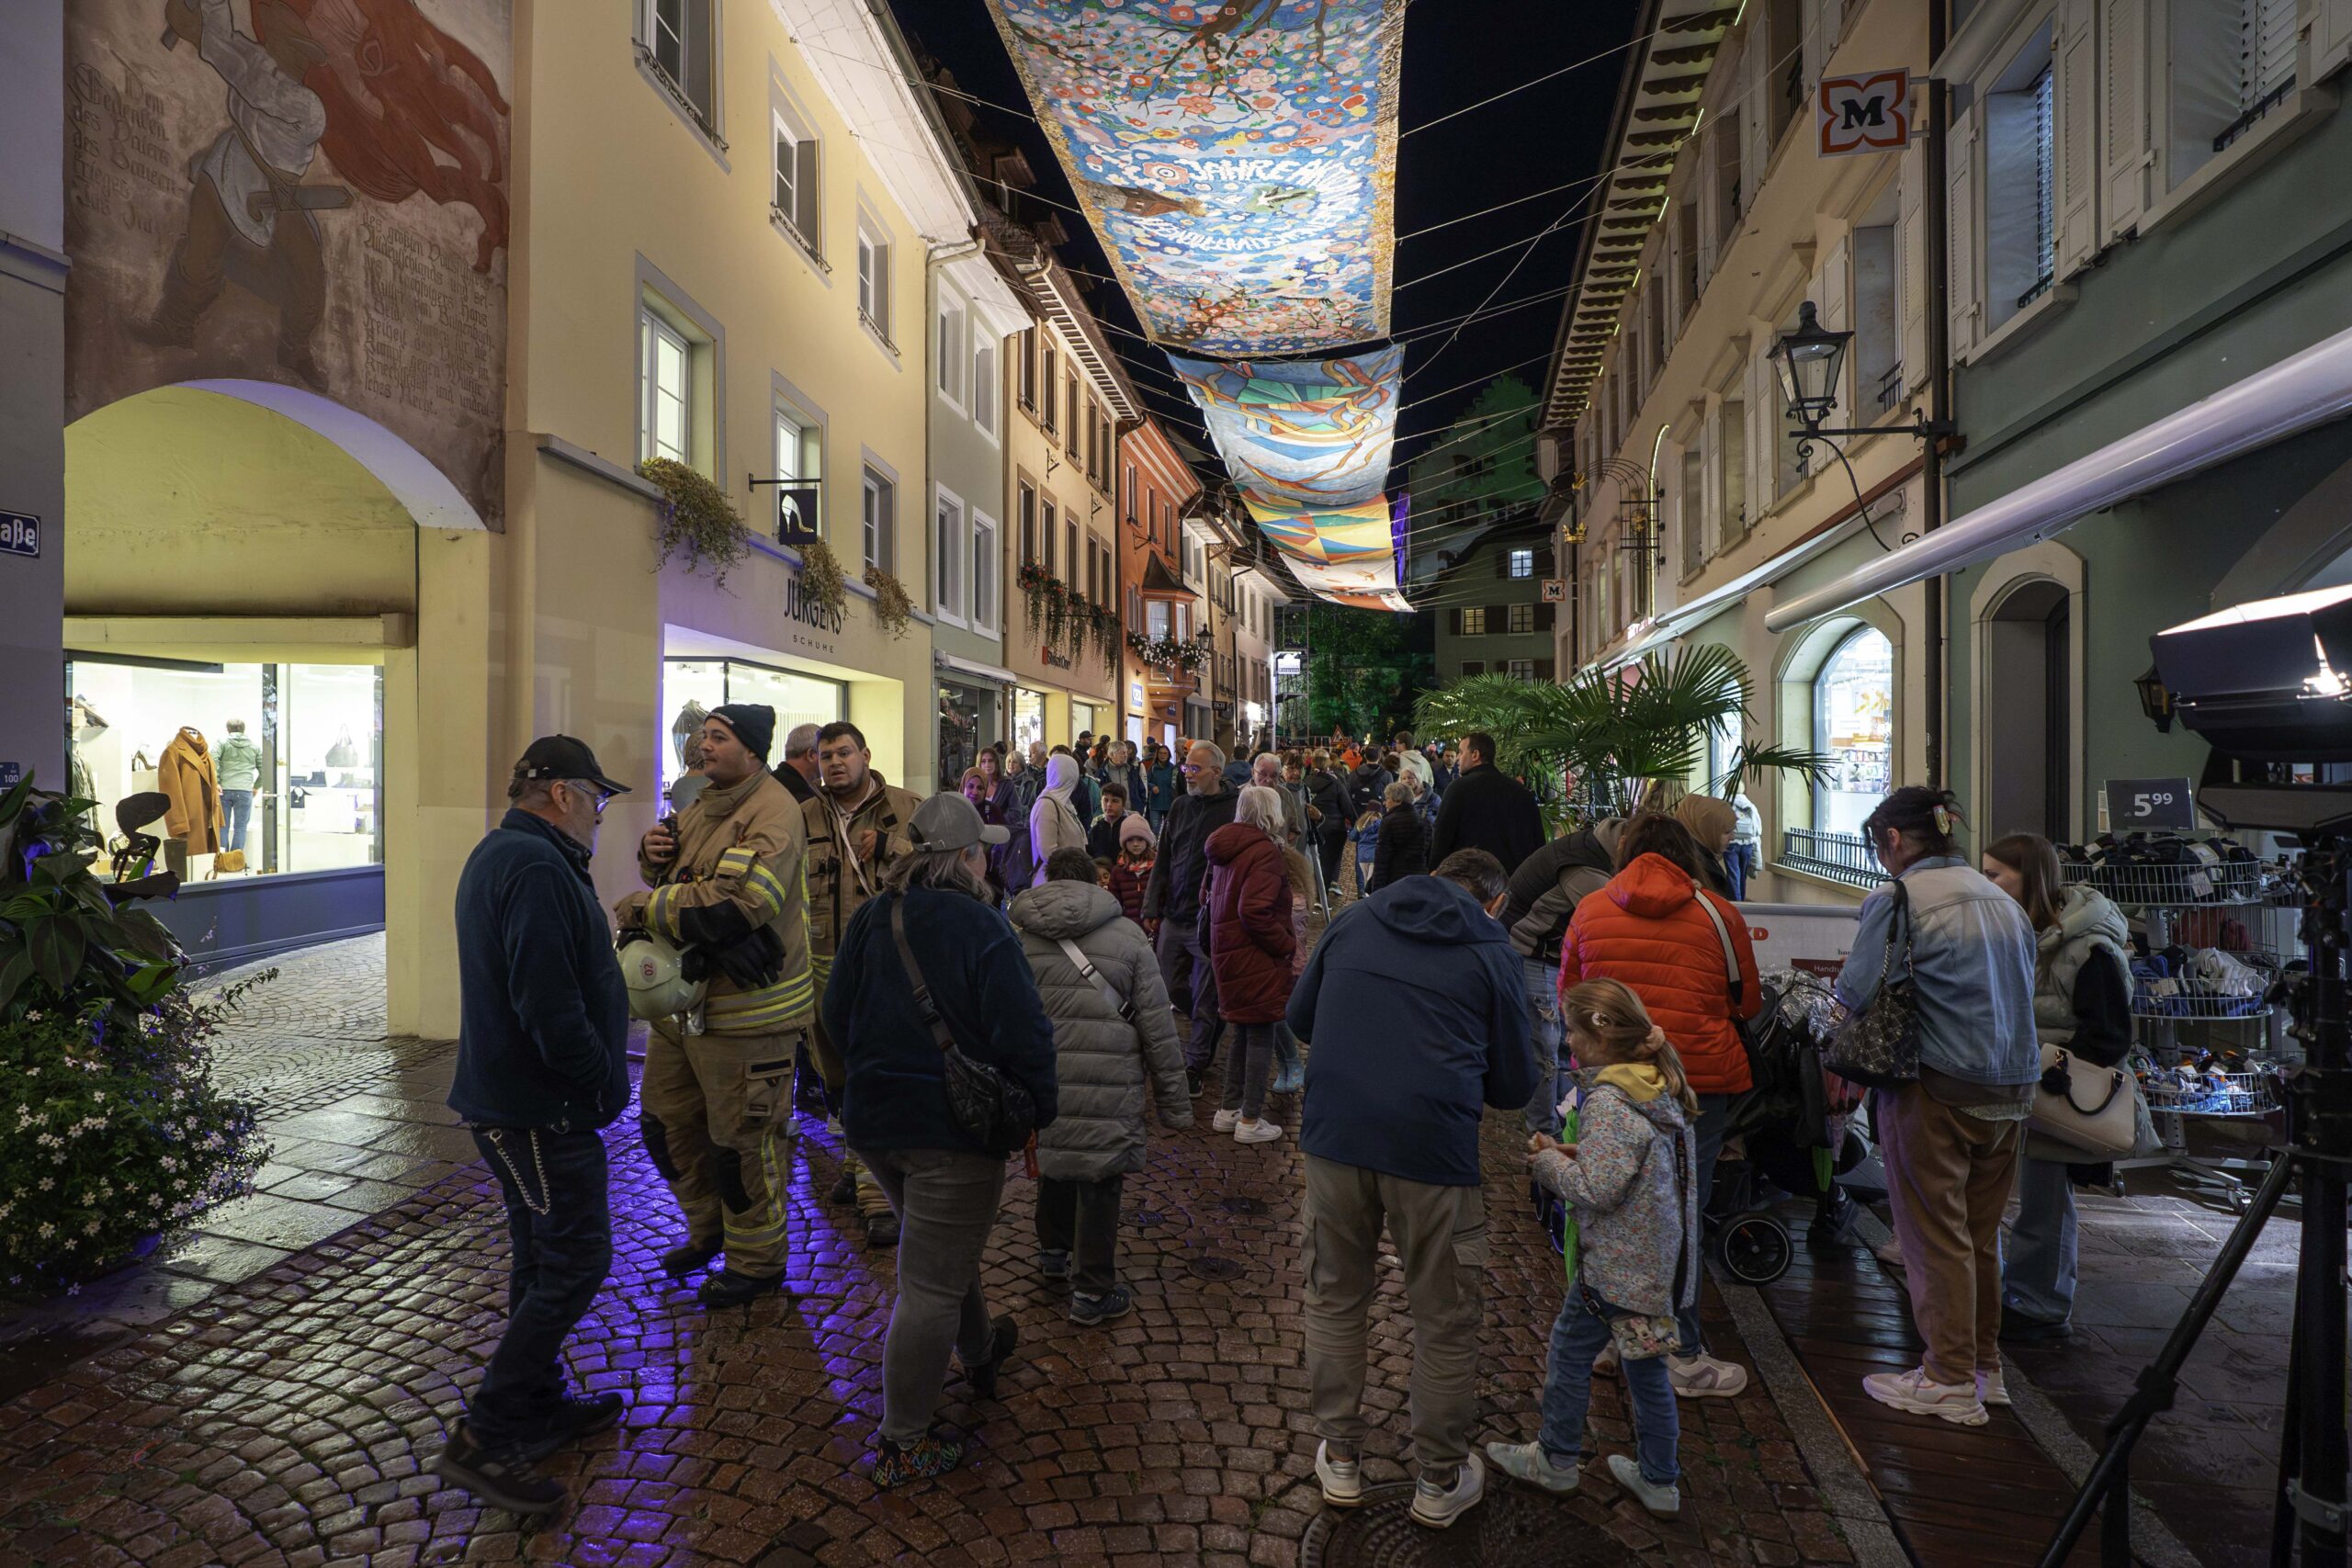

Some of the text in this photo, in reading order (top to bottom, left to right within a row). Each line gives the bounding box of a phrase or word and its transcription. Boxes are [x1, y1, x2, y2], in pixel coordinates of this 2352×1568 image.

[1841, 95, 1884, 130] M
[1174, 157, 1300, 184] JAHRE
[1549, 586, 1560, 595] M
[793, 635, 834, 653] SCHUHE
[5, 774, 18, 783] 100
